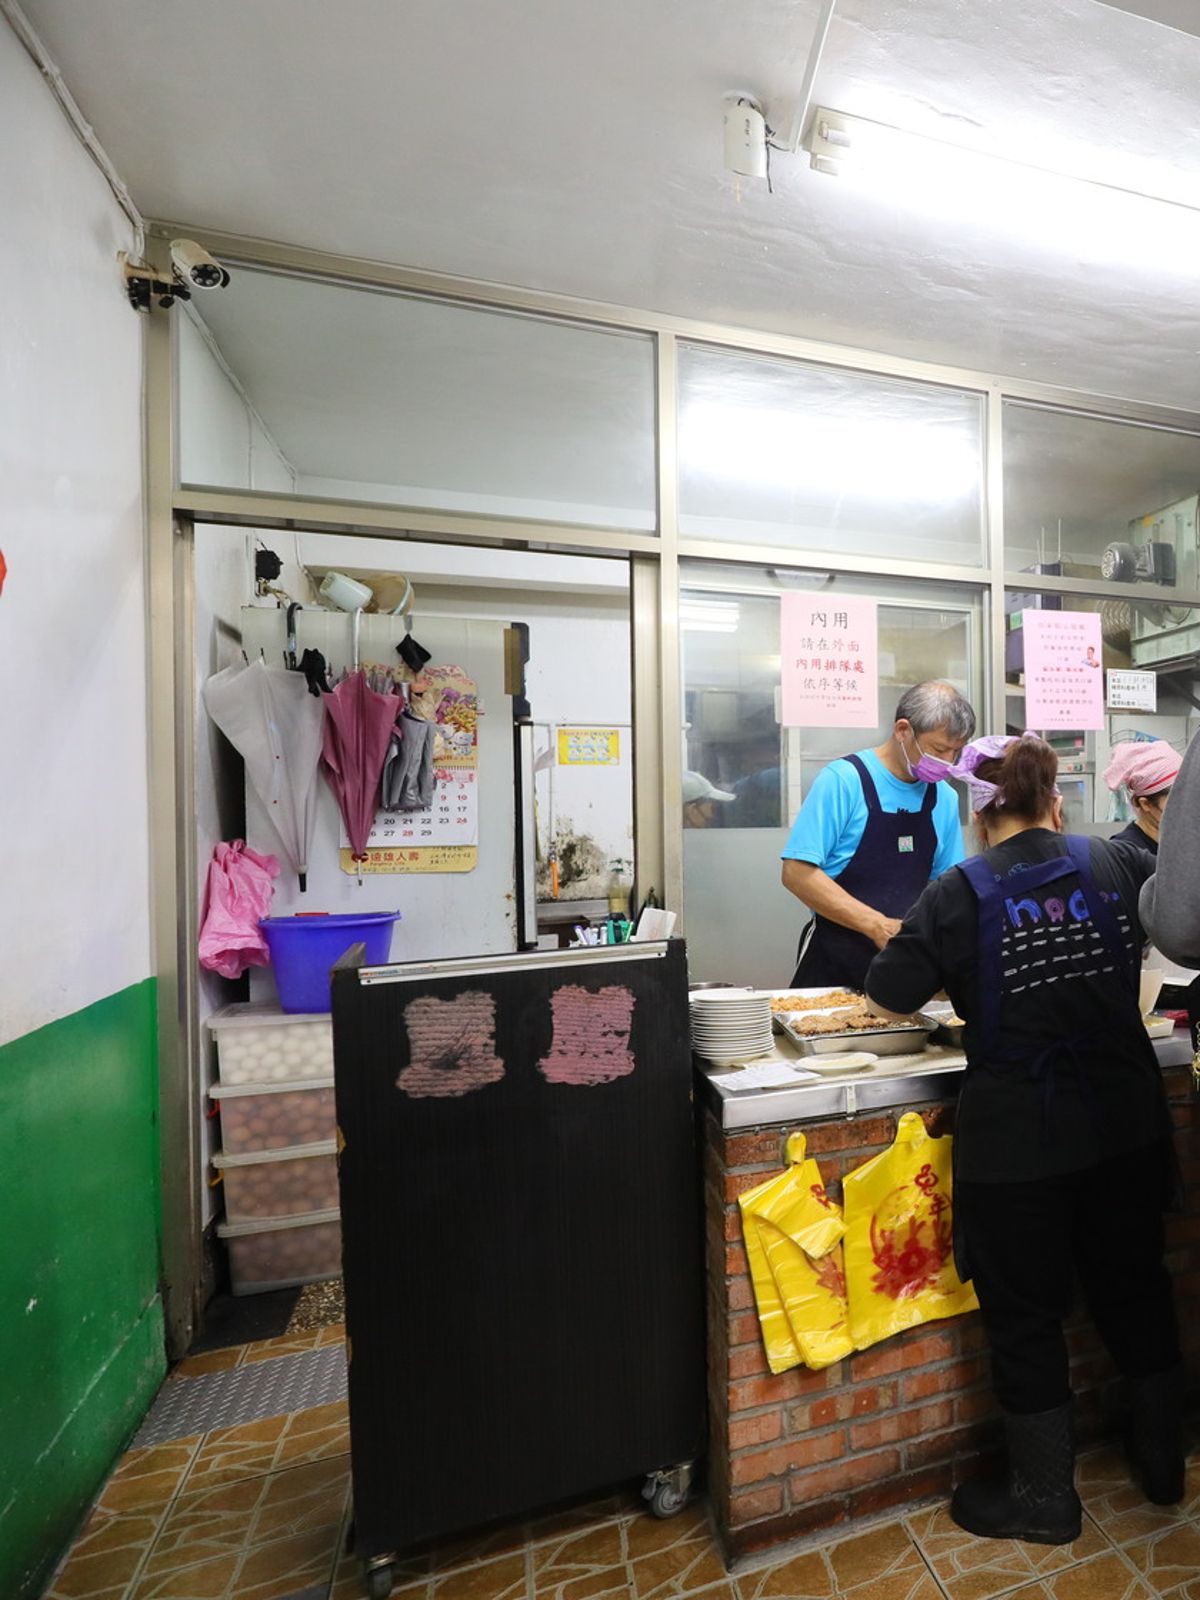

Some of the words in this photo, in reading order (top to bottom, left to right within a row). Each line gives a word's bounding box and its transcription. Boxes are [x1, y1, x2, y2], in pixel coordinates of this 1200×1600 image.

[811, 611, 848, 629] 內用
[800, 637, 860, 652] 請在外面
[796, 658, 865, 673] 內用排隊處
[803, 677, 858, 691] 依序等候
[370, 851, 419, 862] 遠雄人壽
